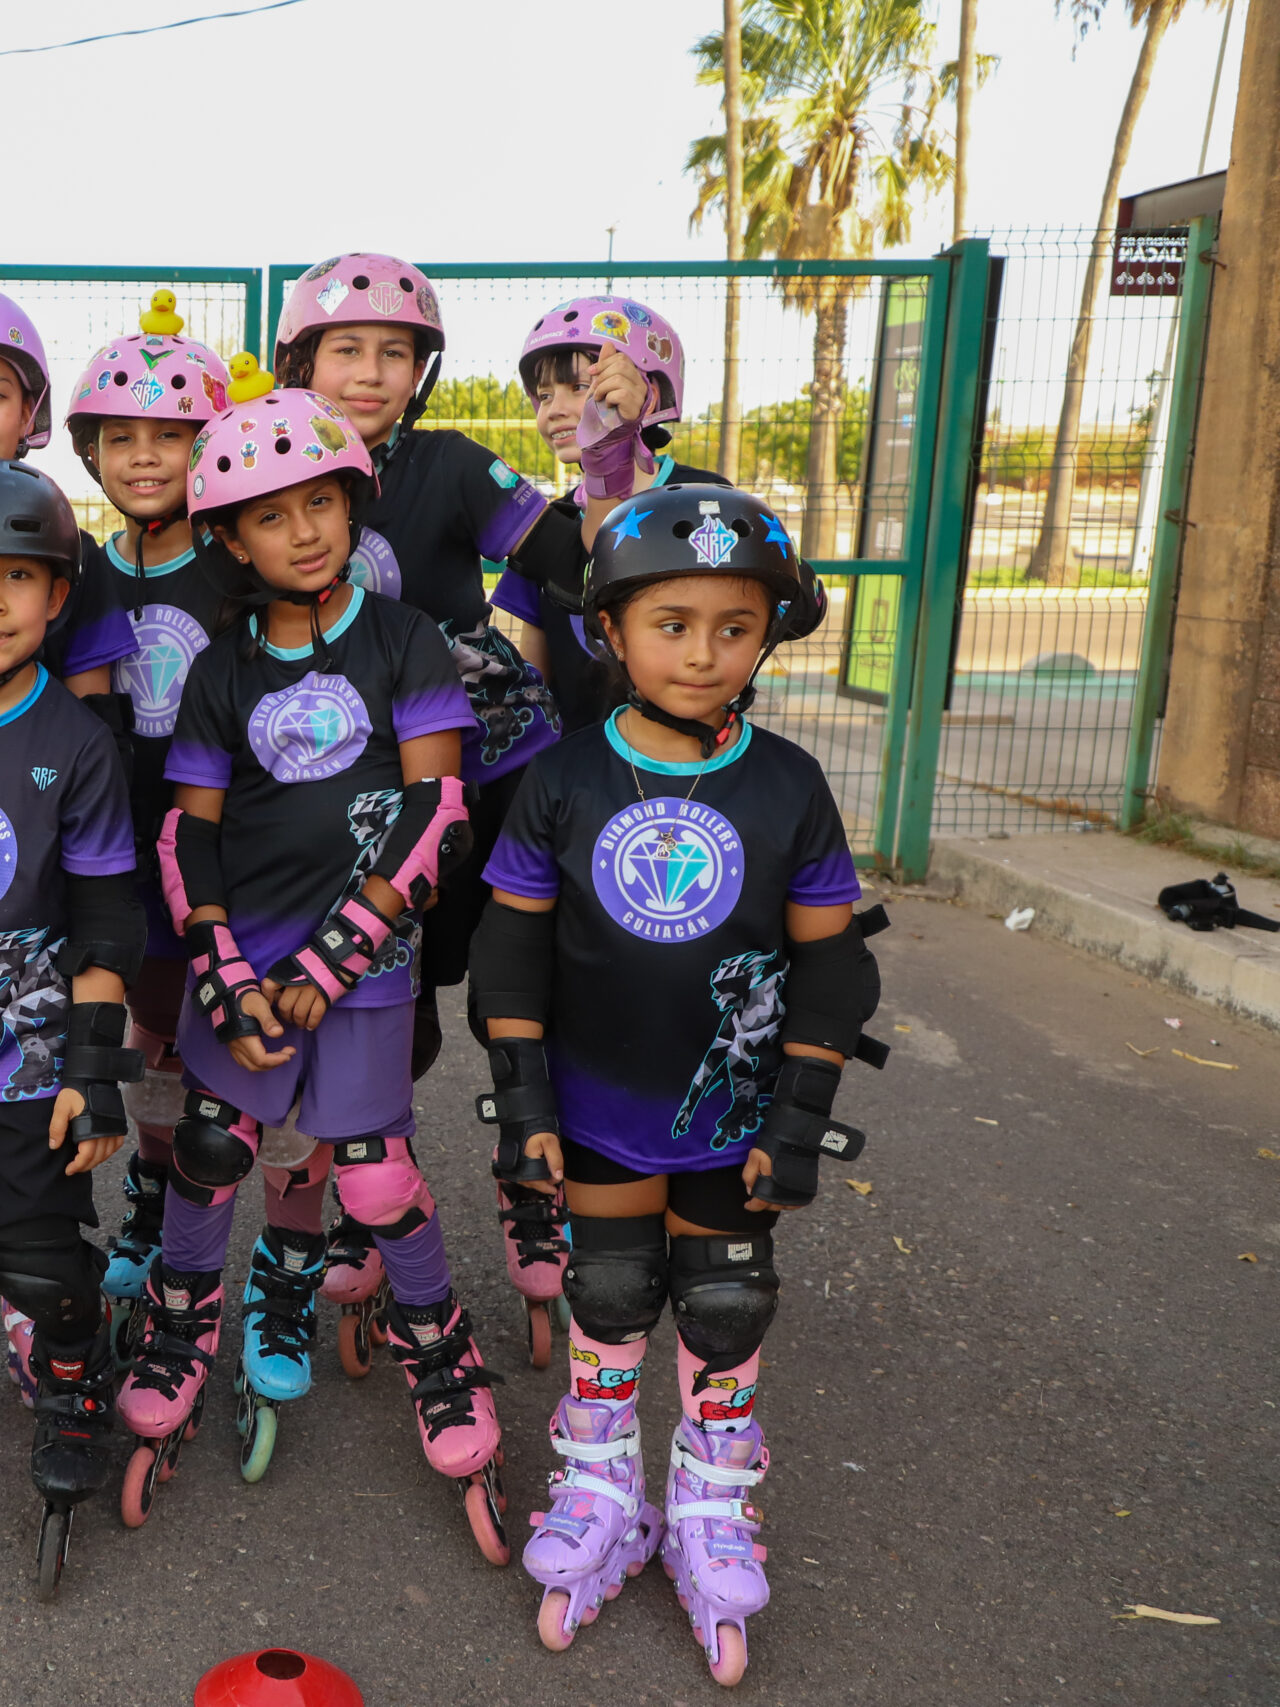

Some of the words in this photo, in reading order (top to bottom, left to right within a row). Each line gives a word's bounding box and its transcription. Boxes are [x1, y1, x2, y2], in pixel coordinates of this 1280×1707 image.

[154, 608, 207, 649] ROLLERS
[313, 675, 360, 709] ROLLERS
[31, 766, 58, 791] DRC
[601, 802, 666, 851] DIAMOND
[679, 803, 738, 852] ROLLERS
[622, 911, 711, 938] CULIACÁN
